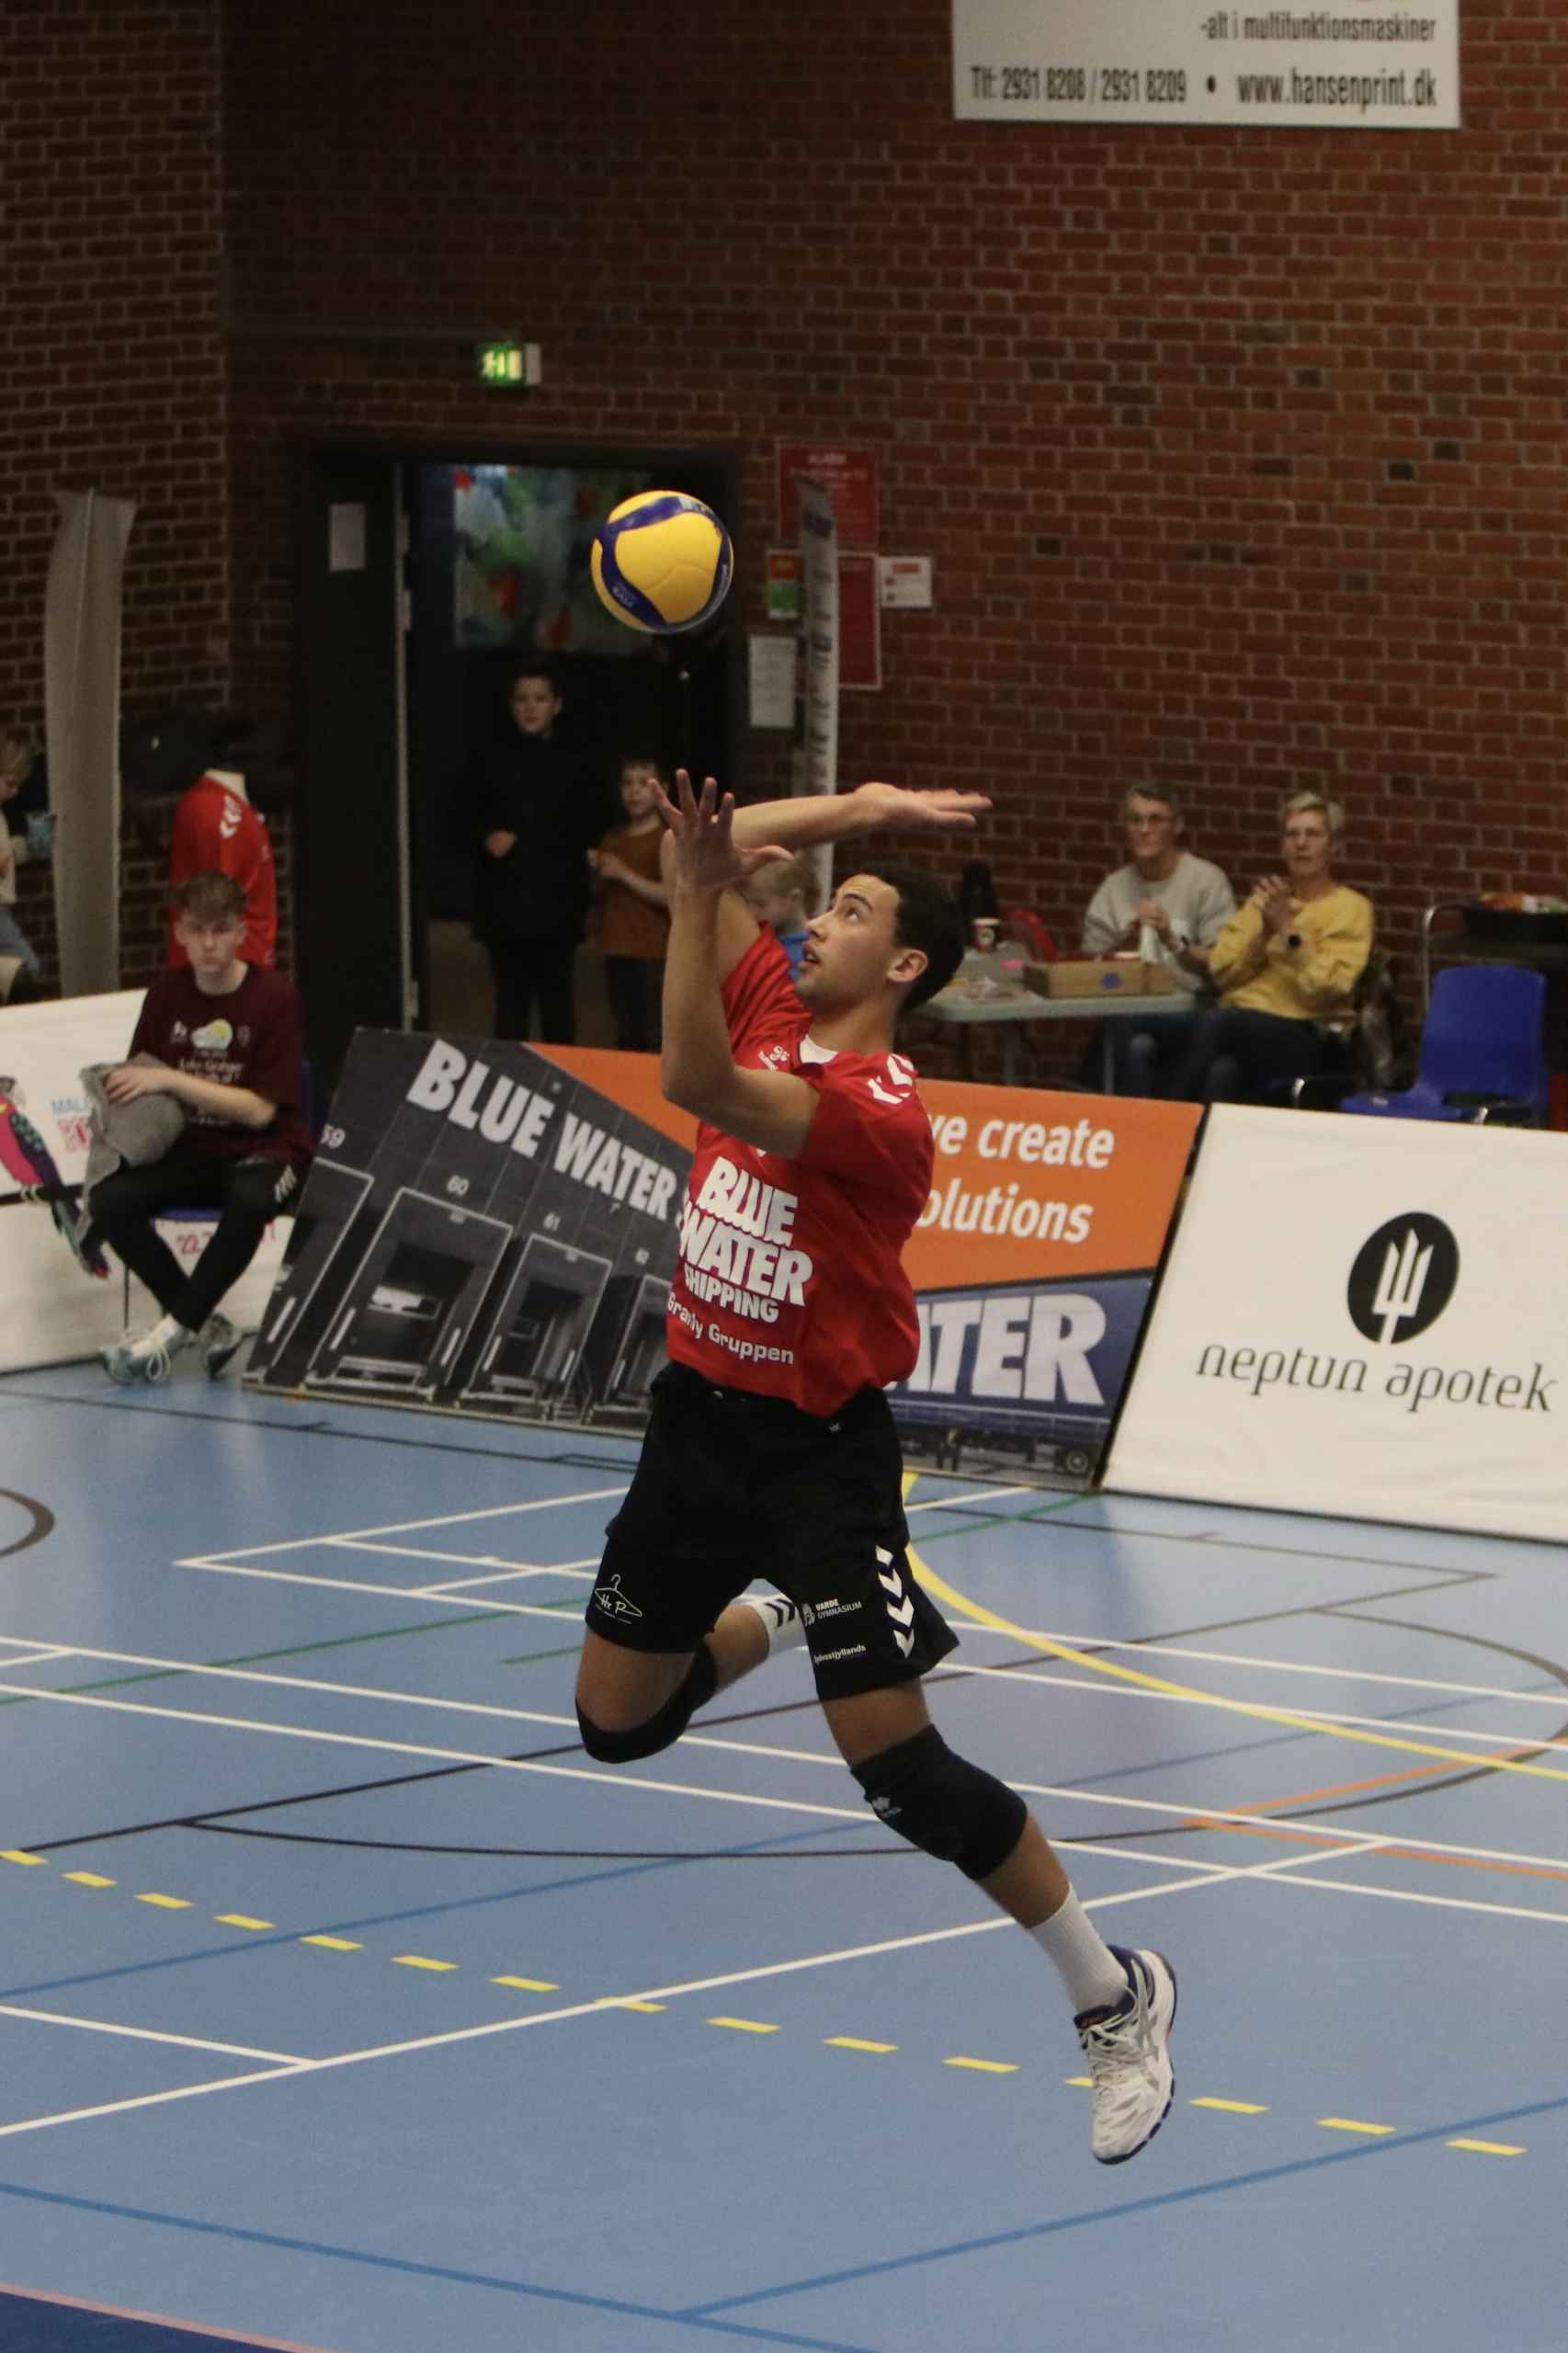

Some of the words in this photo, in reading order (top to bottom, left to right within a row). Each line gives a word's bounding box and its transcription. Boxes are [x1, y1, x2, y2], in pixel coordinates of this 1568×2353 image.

[1244, 10, 1436, 41] multifunktionsmaskiner
[1002, 67, 1040, 100] 2931
[1100, 69, 1140, 102] 2931
[1146, 69, 1187, 103] 8209
[1238, 67, 1437, 114] www.hansenprint.dk
[406, 1038, 555, 1159] BLUE
[553, 1114, 677, 1222] WATER
[977, 1117, 1115, 1169] create
[696, 1155, 798, 1248] BLUE
[916, 1177, 1094, 1244] olutions
[679, 1200, 813, 1306] WATER
[709, 1324, 794, 1364] Gruppen
[882, 1292, 1107, 1405] ATER
[1197, 1343, 1368, 1397] neptun
[1385, 1362, 1559, 1413] apotek
[815, 1598, 839, 1611] VARDE
